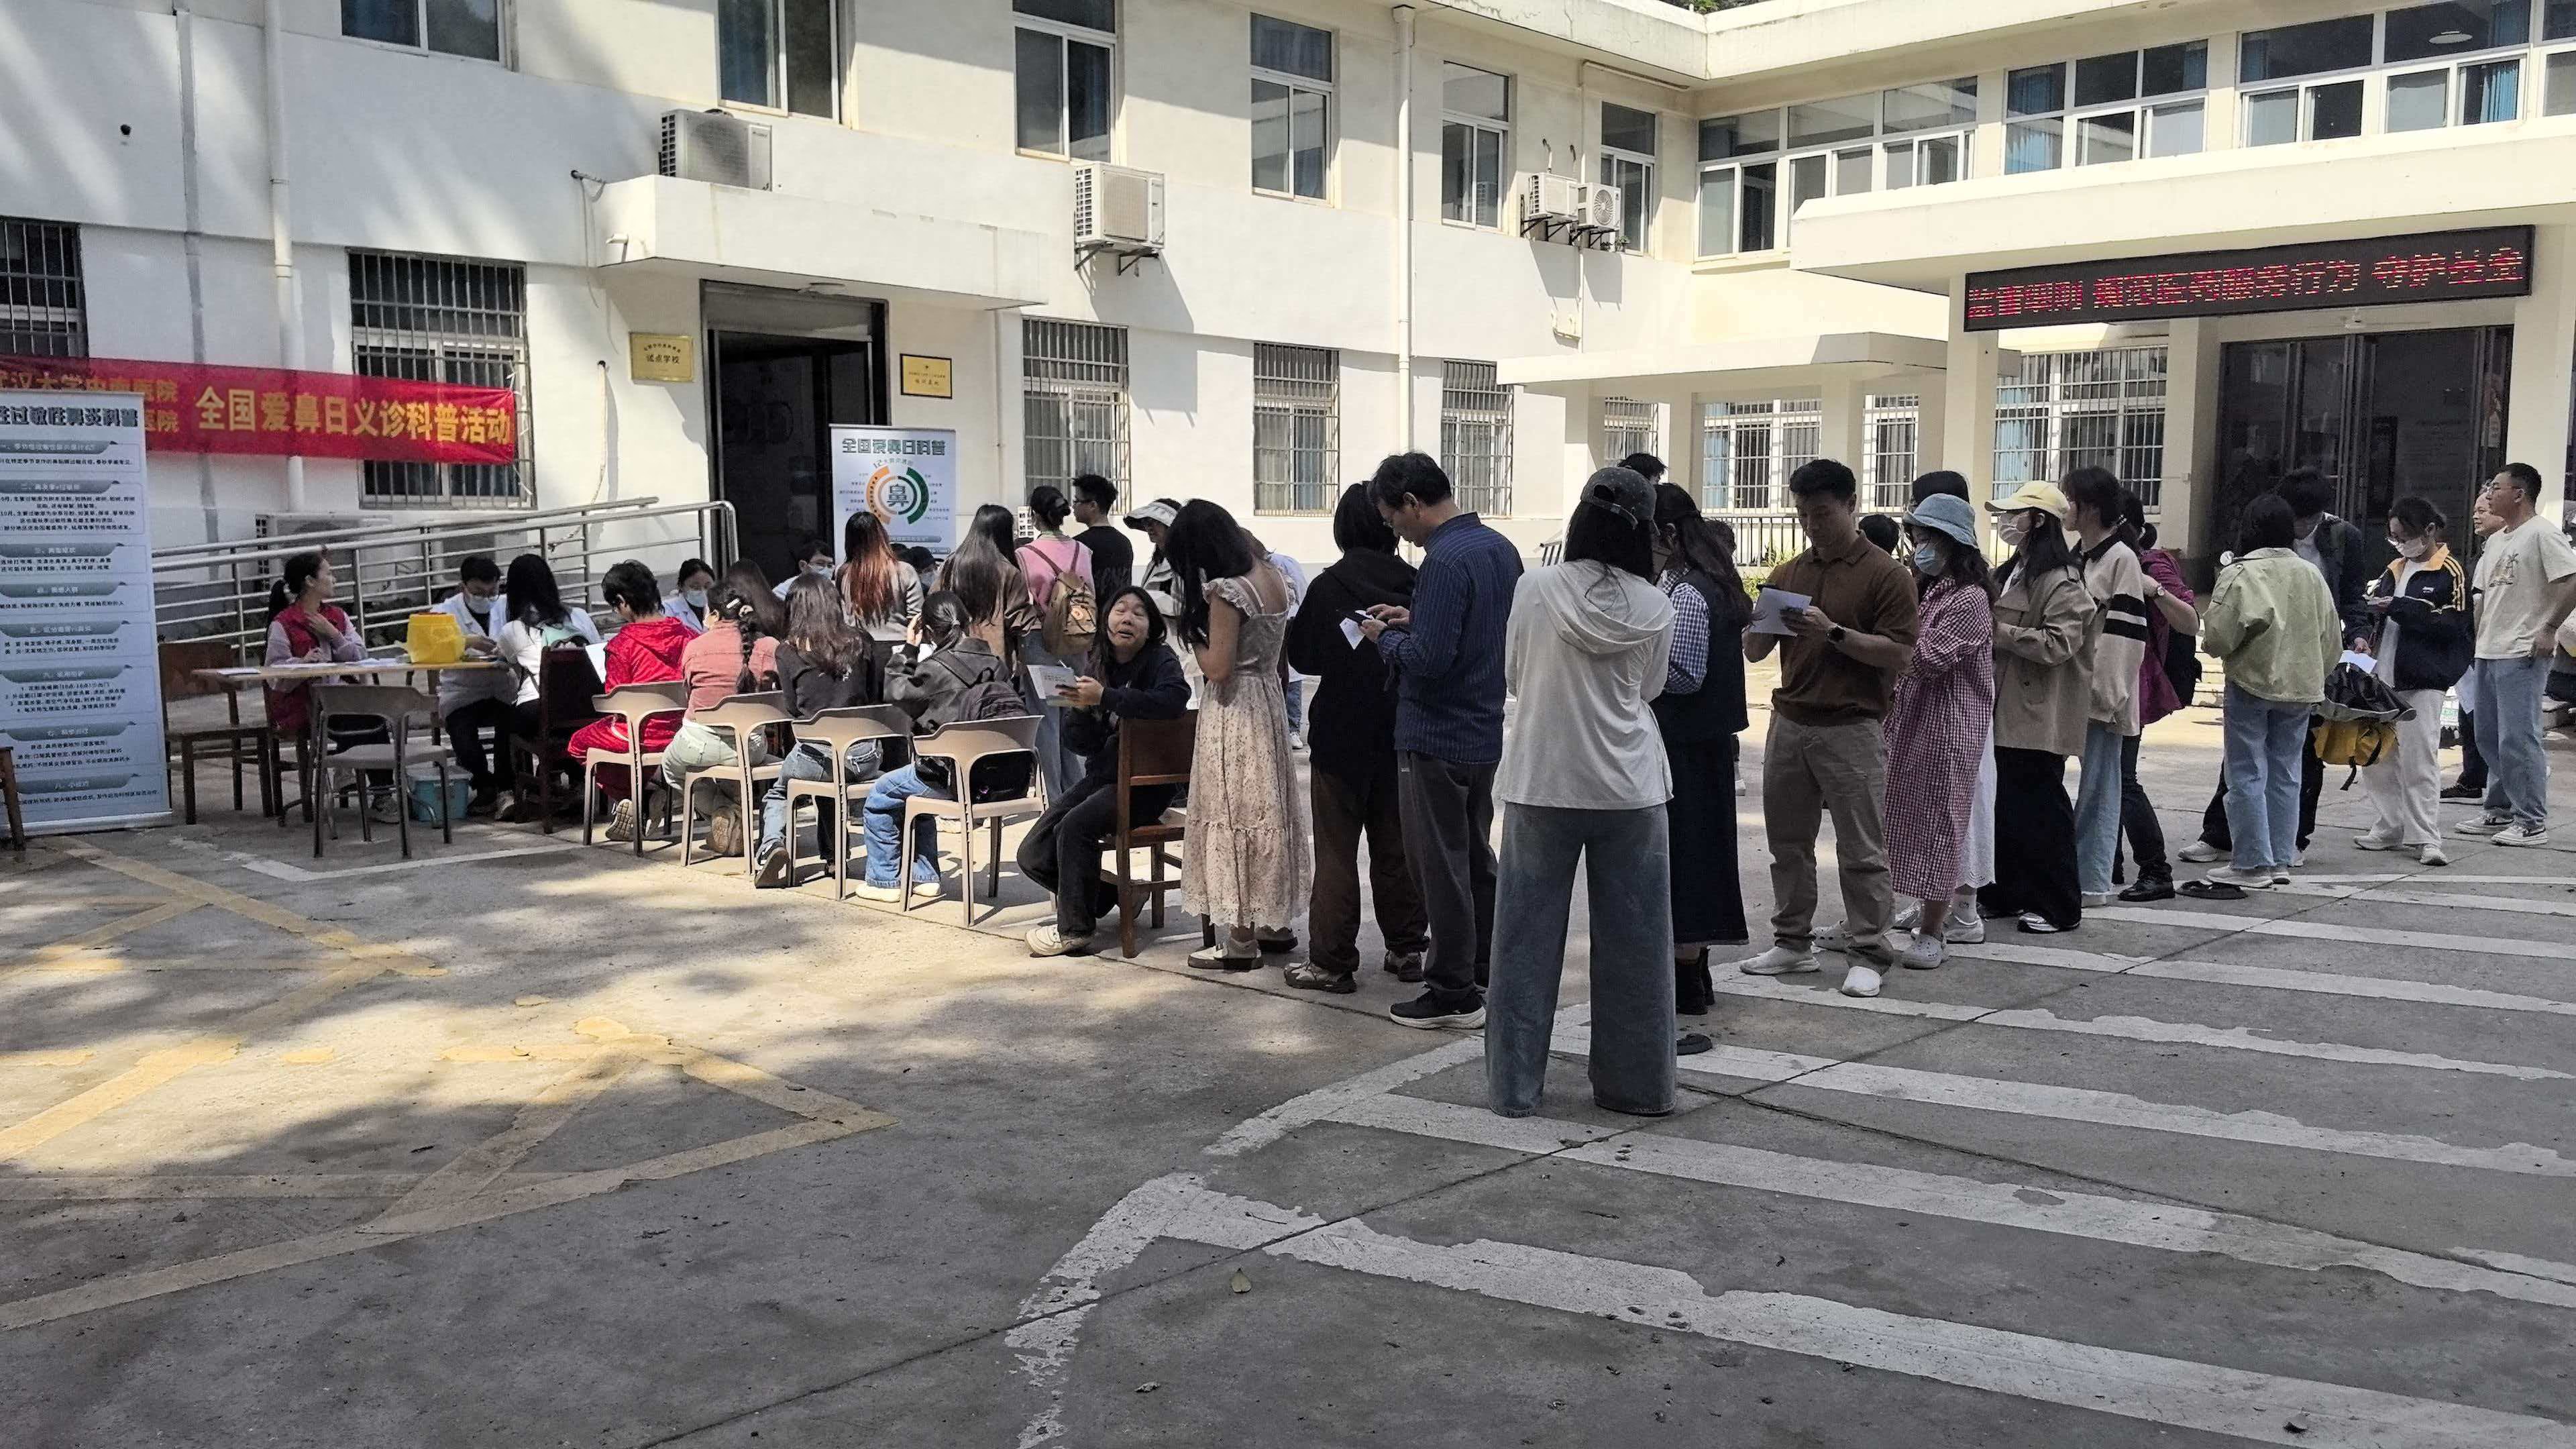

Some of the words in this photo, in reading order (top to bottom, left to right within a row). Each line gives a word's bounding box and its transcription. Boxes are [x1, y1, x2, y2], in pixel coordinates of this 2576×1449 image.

[2371, 247, 2523, 288] 守护基金
[197, 385, 511, 445] 全国爱鼻日义诊科普活动
[887, 483, 909, 507] 鼻
